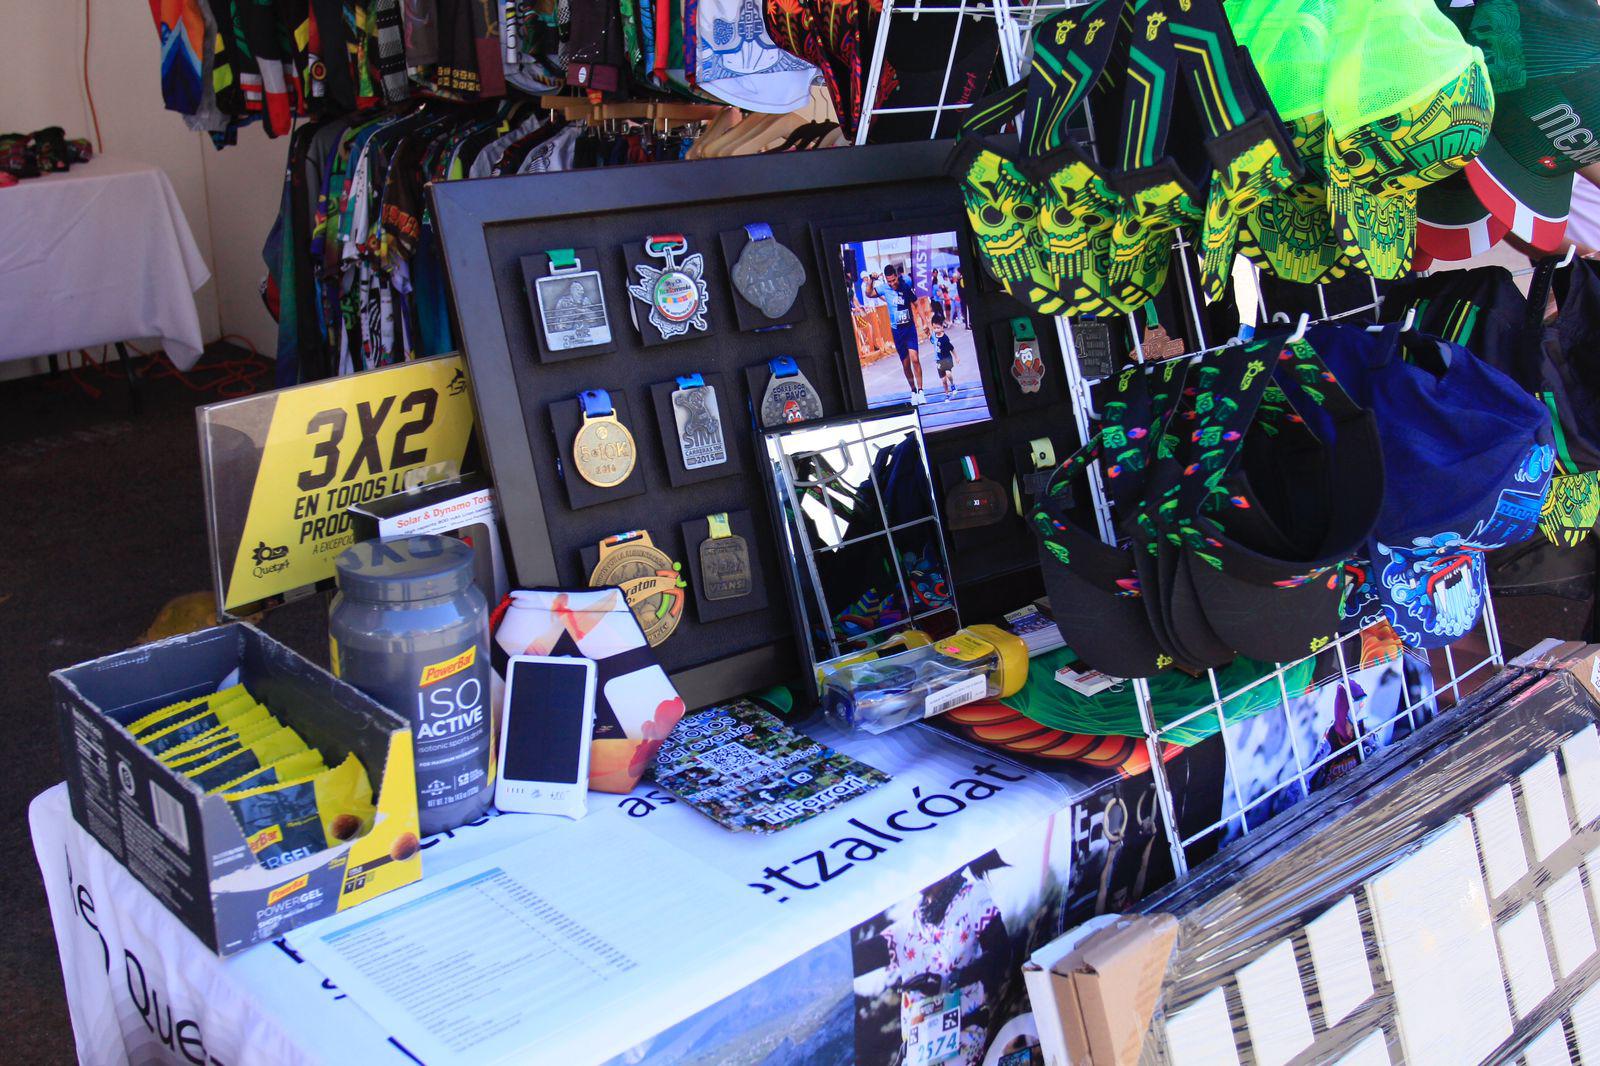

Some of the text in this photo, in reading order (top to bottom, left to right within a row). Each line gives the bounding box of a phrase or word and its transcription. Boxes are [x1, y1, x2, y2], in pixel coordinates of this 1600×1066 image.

[786, 389, 807, 400] PAVO
[297, 387, 438, 492] 3X2
[685, 447, 713, 457] CARRERAS
[696, 453, 716, 464] 2015
[294, 491, 319, 520] EN
[327, 475, 387, 511] TODOS
[299, 511, 353, 545] PROD
[397, 514, 422, 528] Solar
[423, 511, 430, 520] &
[433, 501, 471, 517] Dynamo
[426, 653, 473, 681] PowerBar
[418, 678, 481, 721] ISO
[417, 705, 483, 739] ACTIVE
[673, 717, 736, 745] FOTOS
[418, 743, 449, 753] isotonic
[449, 735, 470, 748] sports
[657, 724, 752, 764] del evento
[757, 775, 867, 824] TriFerrari
[256, 887, 324, 920] POWERGEL
[918, 1031, 958, 1061] 2574
